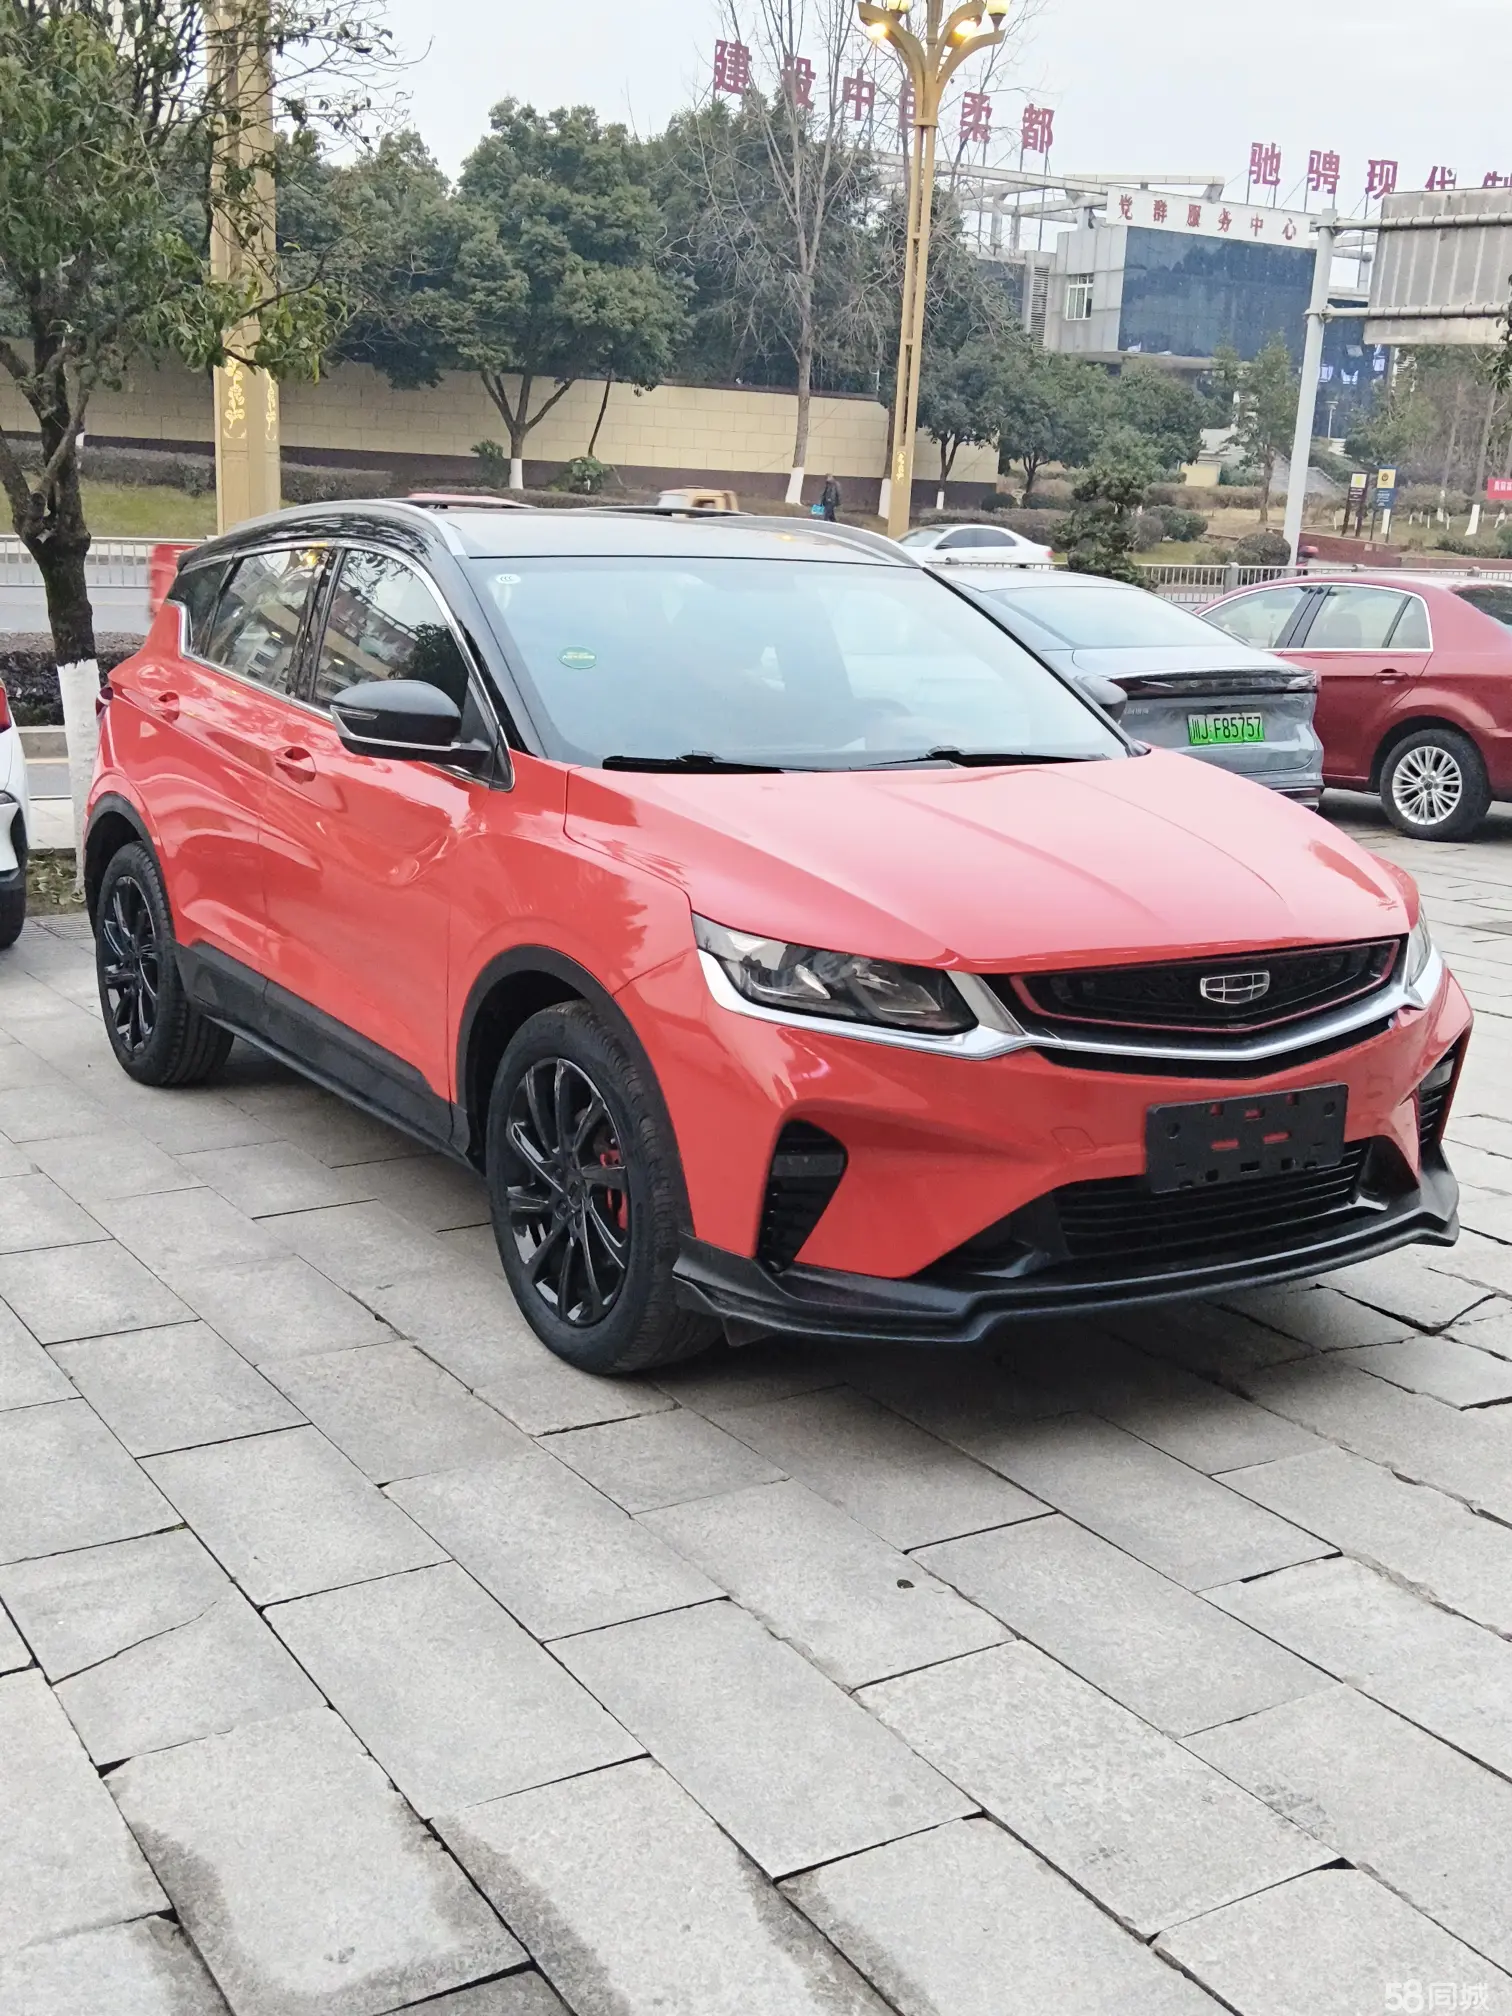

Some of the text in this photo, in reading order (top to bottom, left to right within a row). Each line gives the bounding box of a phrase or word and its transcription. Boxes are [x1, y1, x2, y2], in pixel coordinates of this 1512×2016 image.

[1248, 142, 1512, 200] 驰骋现代
[1118, 194, 1297, 241] 党群服务中心
